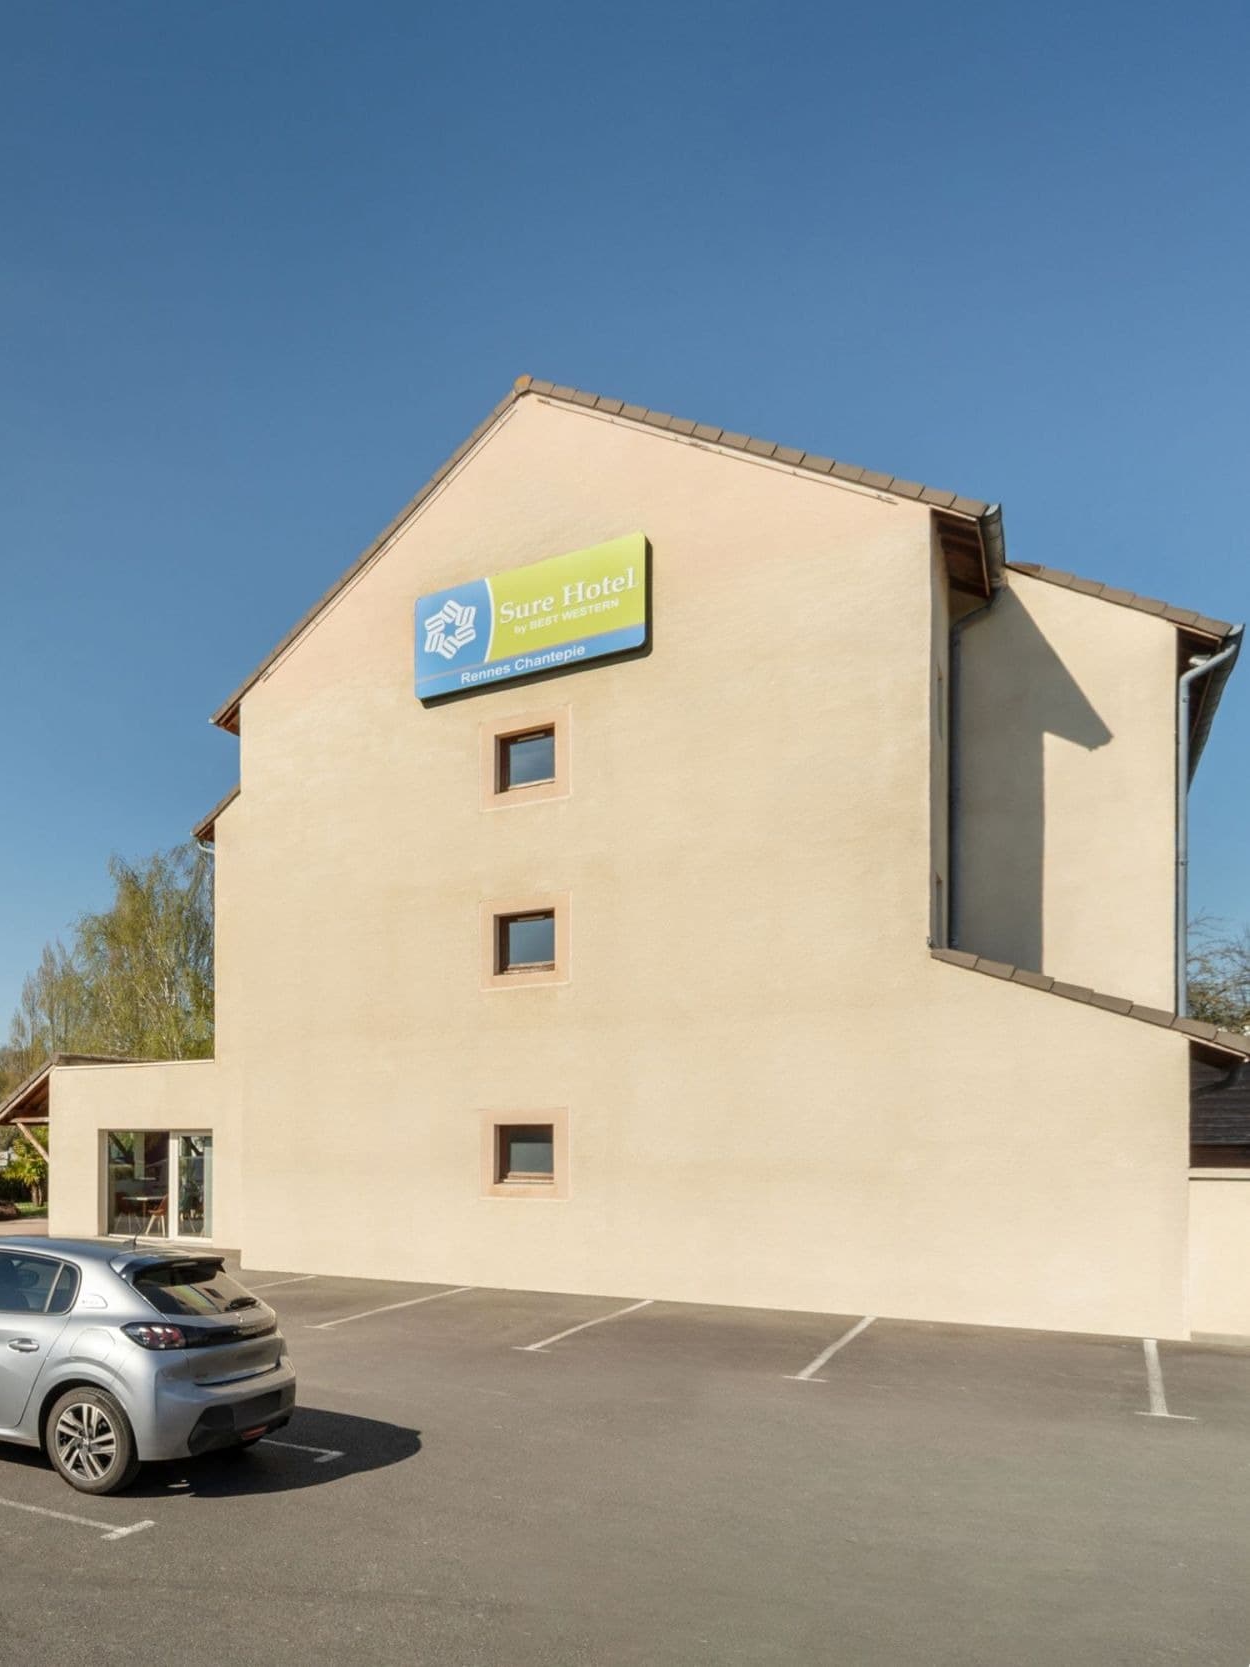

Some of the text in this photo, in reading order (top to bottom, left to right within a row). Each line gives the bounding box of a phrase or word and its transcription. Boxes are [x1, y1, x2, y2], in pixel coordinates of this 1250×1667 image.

[500, 567, 637, 623] Sure Hotel
[514, 598, 619, 635] by BEST WESTERN
[461, 646, 586, 684] Rennes Chantepie
